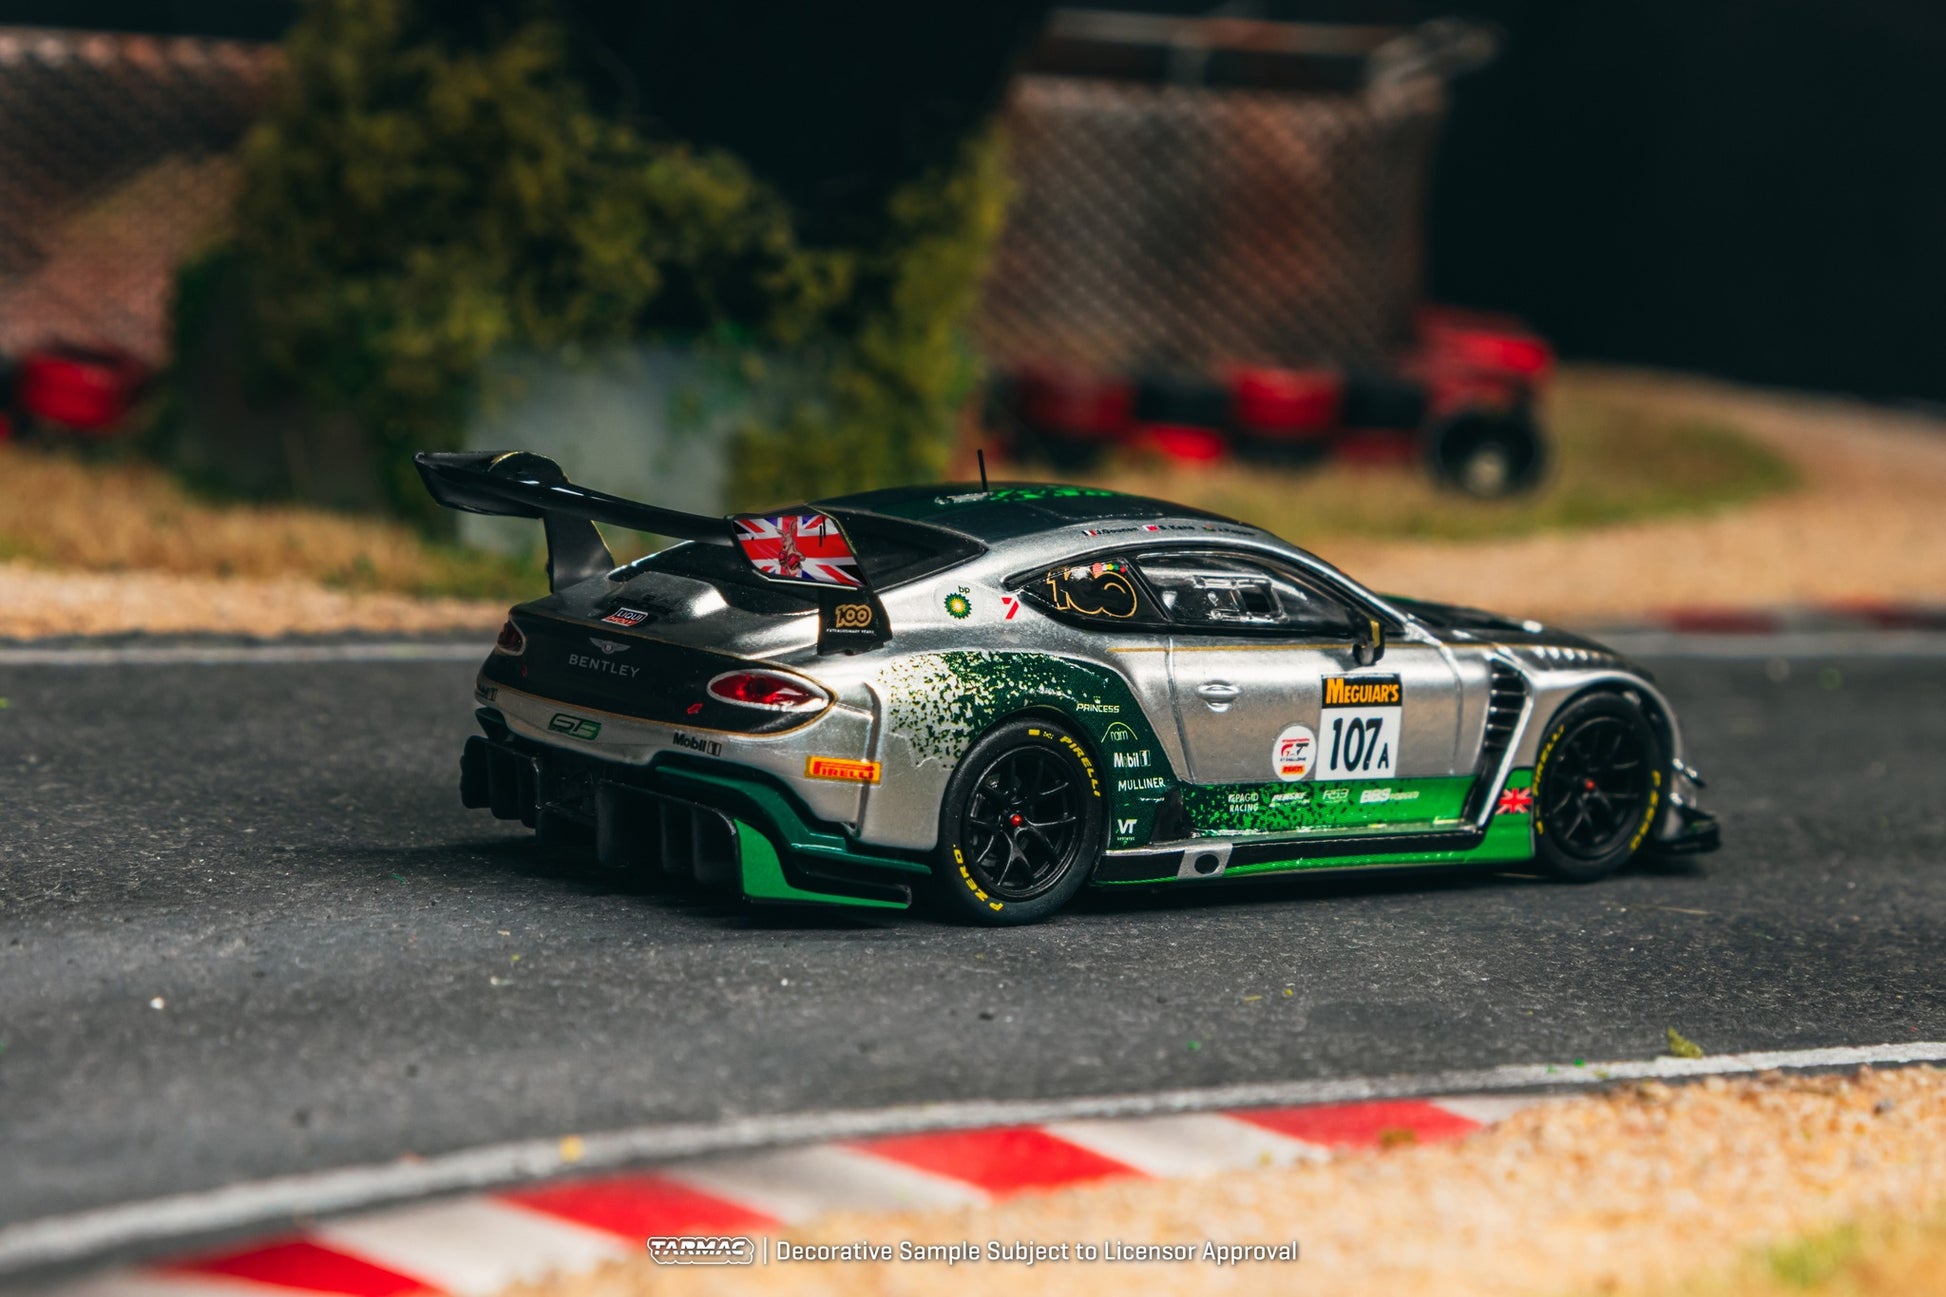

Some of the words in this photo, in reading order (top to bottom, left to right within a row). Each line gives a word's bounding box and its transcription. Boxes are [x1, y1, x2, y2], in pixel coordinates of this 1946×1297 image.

[958, 585, 971, 594] bp
[616, 610, 645, 621] LIQUI
[835, 604, 873, 628] 100
[568, 653, 640, 679] BENTLEY
[1076, 702, 1120, 713] PRINCESS
[1110, 728, 1129, 741] naim
[673, 732, 707, 752] Mobil
[709, 741, 721, 757] 1
[1060, 735, 1101, 797] PIRELLI
[1141, 750, 1150, 766] 1
[813, 760, 875, 781] PIRELLI
[1117, 777, 1166, 791] MULLINER
[1229, 802, 1259, 812] RACING
[1117, 818, 1138, 834] VT
[953, 849, 989, 902] ZERO
[989, 902, 1004, 911] P
